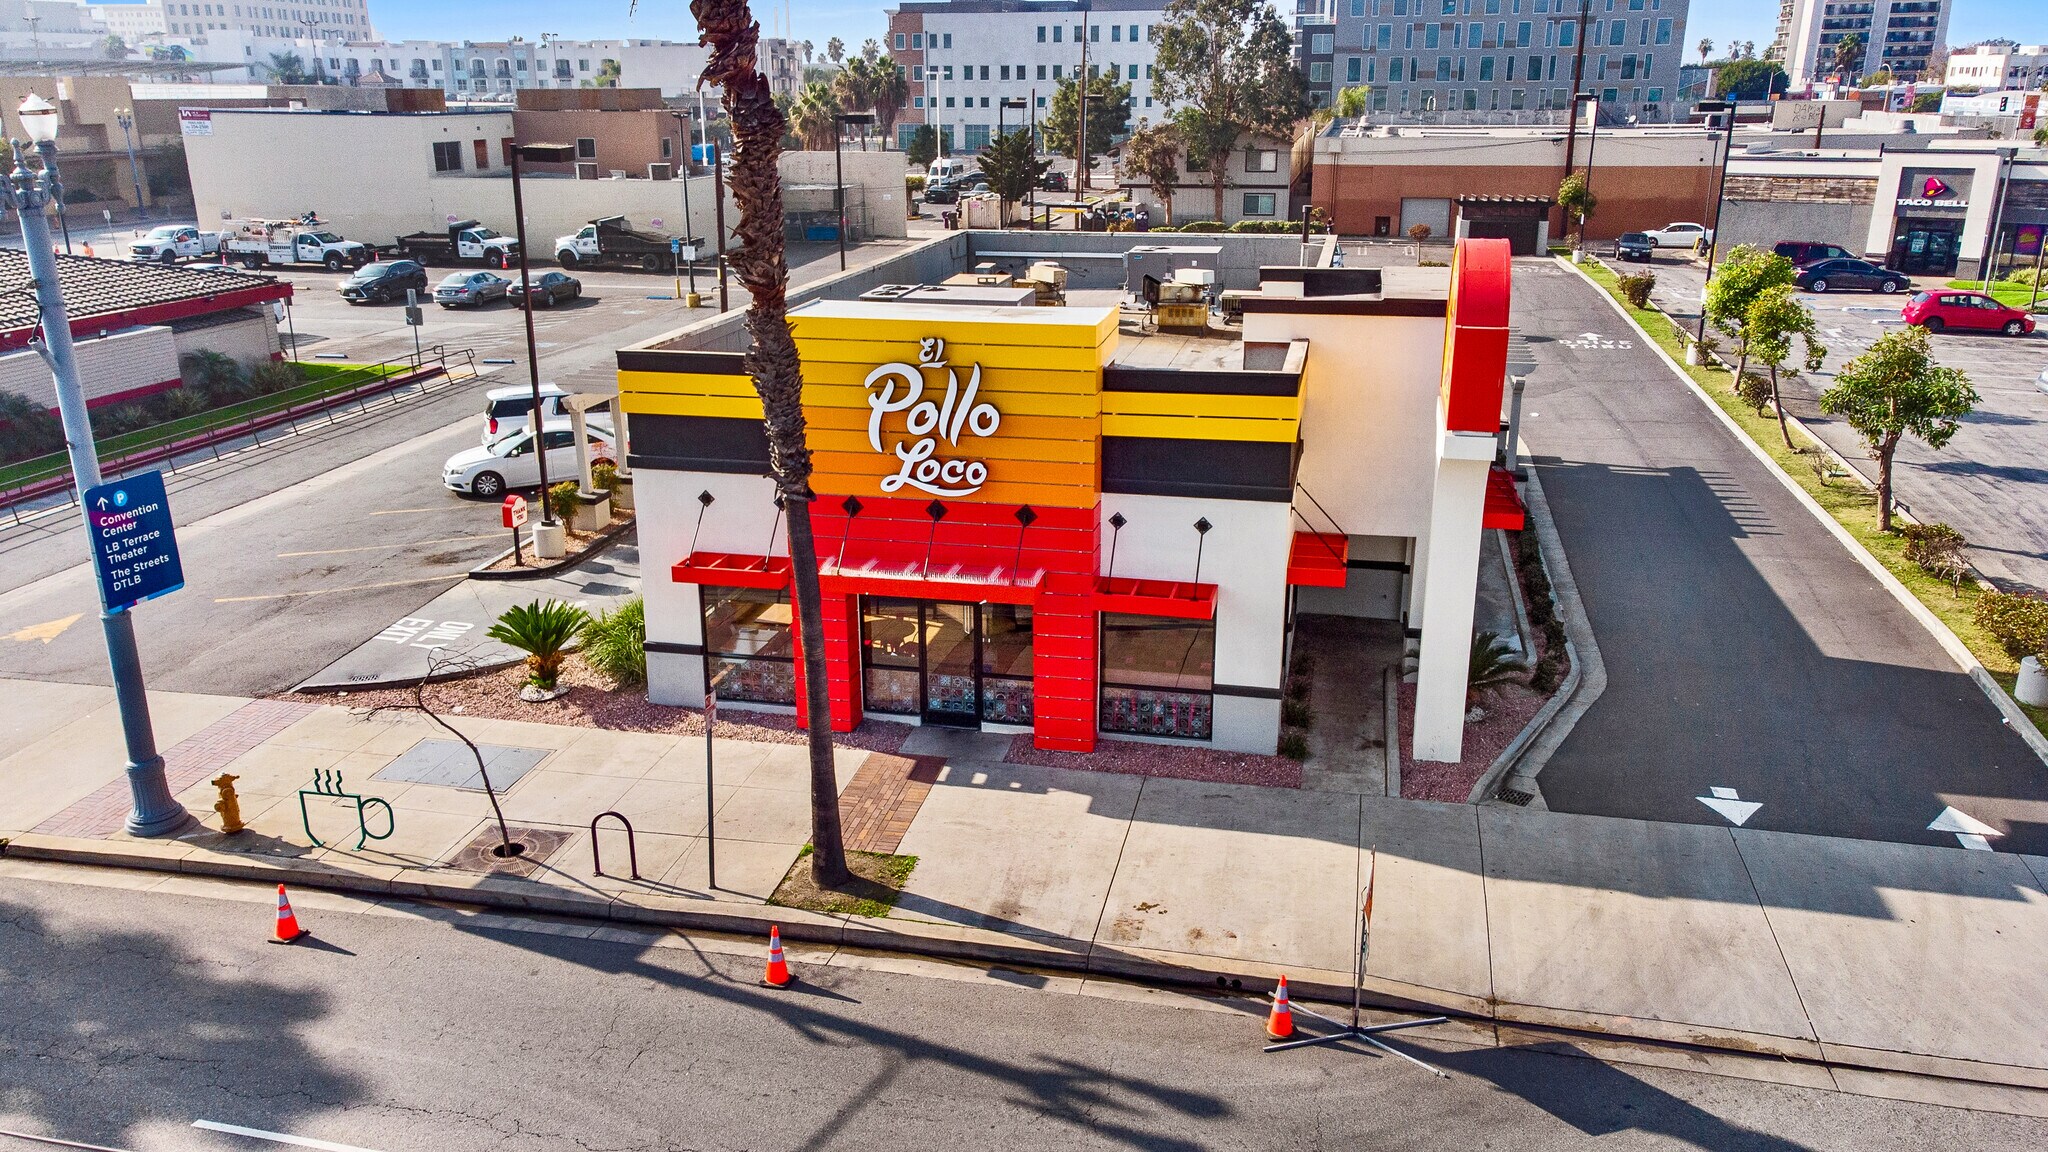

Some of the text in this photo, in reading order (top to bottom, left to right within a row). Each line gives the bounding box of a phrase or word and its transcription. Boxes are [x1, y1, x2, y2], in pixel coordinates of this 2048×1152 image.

[1897, 198, 1969, 207] TACO BELL
[864, 362, 1000, 453] Pollo
[880, 437, 988, 497] Loco
[100, 503, 159, 527] Convention
[102, 521, 138, 538] Center
[105, 530, 160, 554] LB Terrace
[107, 545, 148, 565] Theater
[111, 554, 170, 580] The Streets
[113, 575, 142, 592] DTLB
[374, 617, 434, 645] EXIT
[409, 621, 475, 652] ONLY
